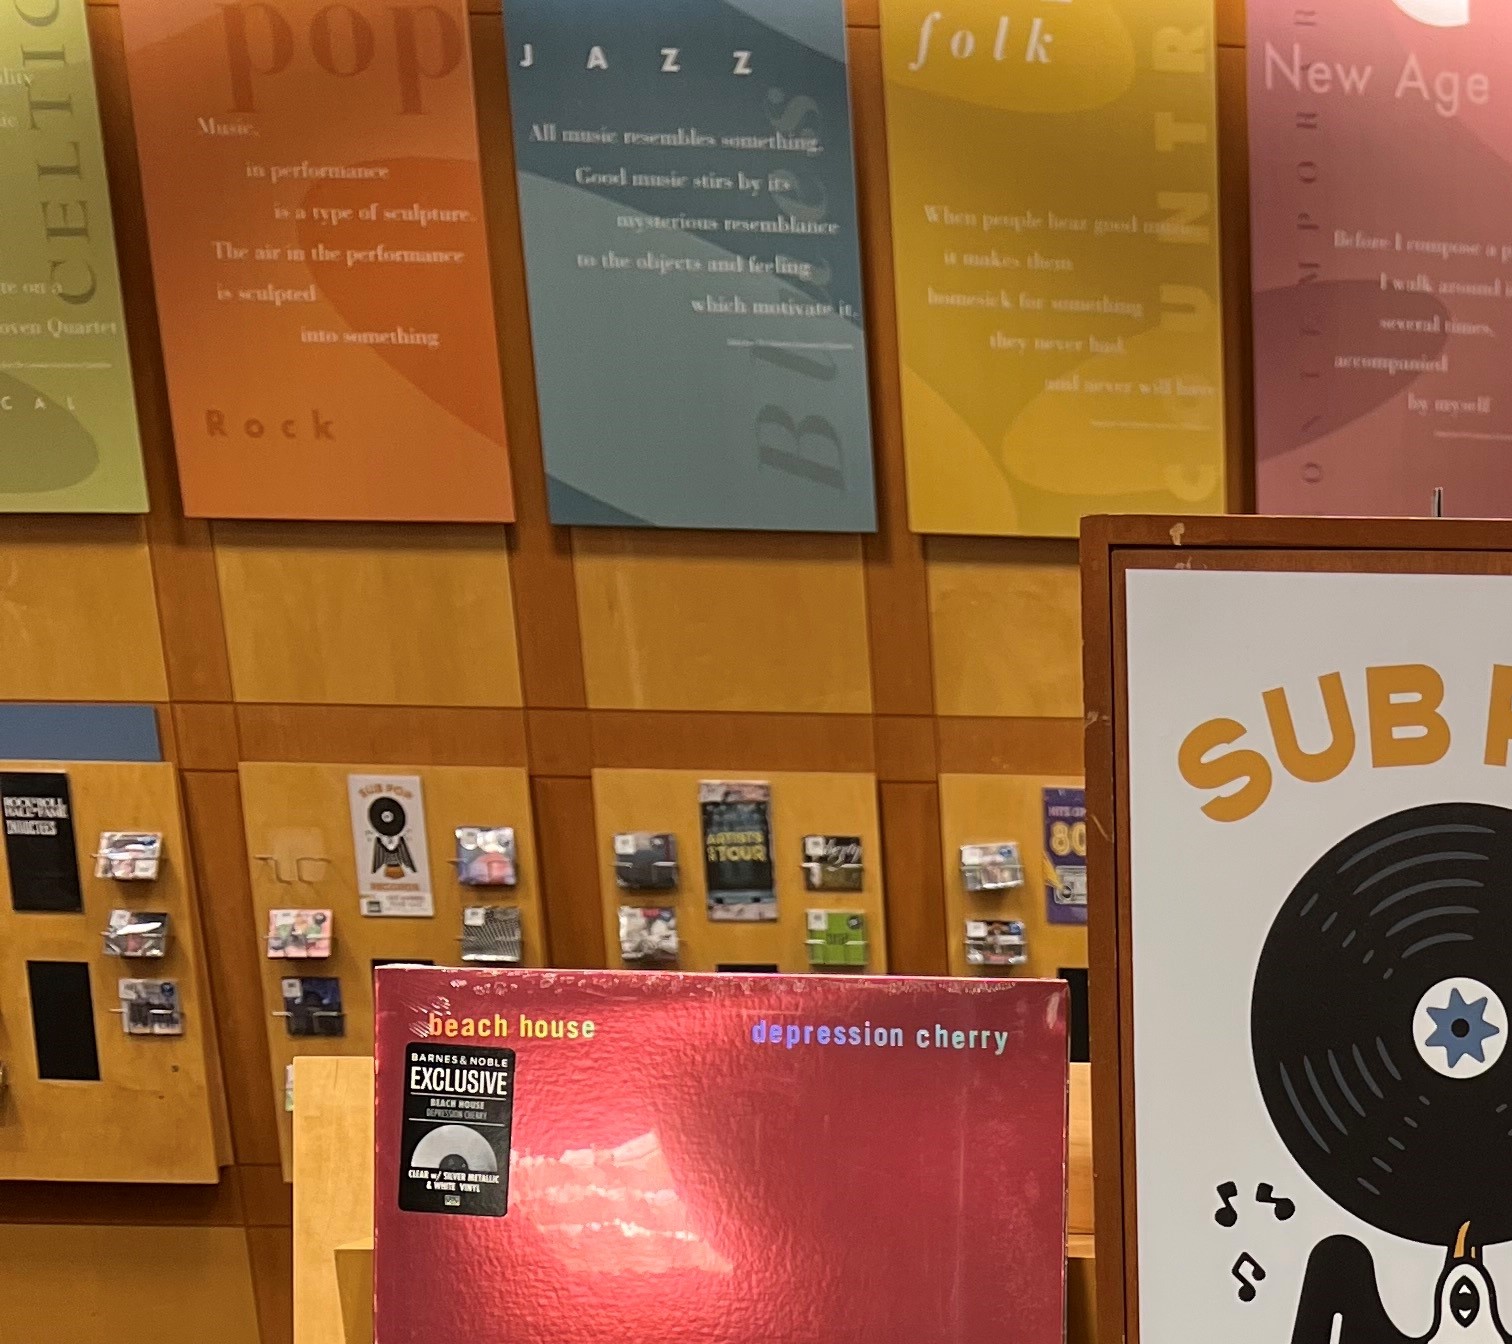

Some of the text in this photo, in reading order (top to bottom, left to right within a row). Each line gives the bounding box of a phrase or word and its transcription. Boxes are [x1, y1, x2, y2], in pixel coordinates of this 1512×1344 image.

[908, 11, 1055, 71] folk
[222, 0, 466, 115] pop
[1263, 40, 1491, 118] New Age
[529, 122, 557, 142] All
[562, 125, 618, 144] music
[623, 127, 717, 147] resembles
[245, 160, 390, 184] in performance
[575, 165, 628, 187] Good
[631, 169, 690, 189] music
[692, 170, 735, 190] stirs
[738, 170, 764, 197] by
[273, 202, 291, 220] is
[312, 203, 354, 226] type
[358, 203, 380, 221] of
[616, 213, 841, 236] mysterious resemblance
[211, 241, 466, 269] The air in the performance
[576, 250, 814, 280] to the objects and feeling
[1153, 25, 1217, 503] COUNTR
[216, 281, 318, 306] is sculpted
[691, 294, 834, 319] which motivate
[300, 326, 442, 350] into something
[1333, 353, 1449, 376] accompanied
[204, 408, 336, 441] Rock
[1178, 663, 1452, 824] SUB
[427, 1012, 597, 1039] beach house
[751, 1019, 1009, 1056] depression cherry
[411, 1052, 509, 1068] BARNES NOBLE
[410, 1066, 508, 1096] EXCLUSIVE
